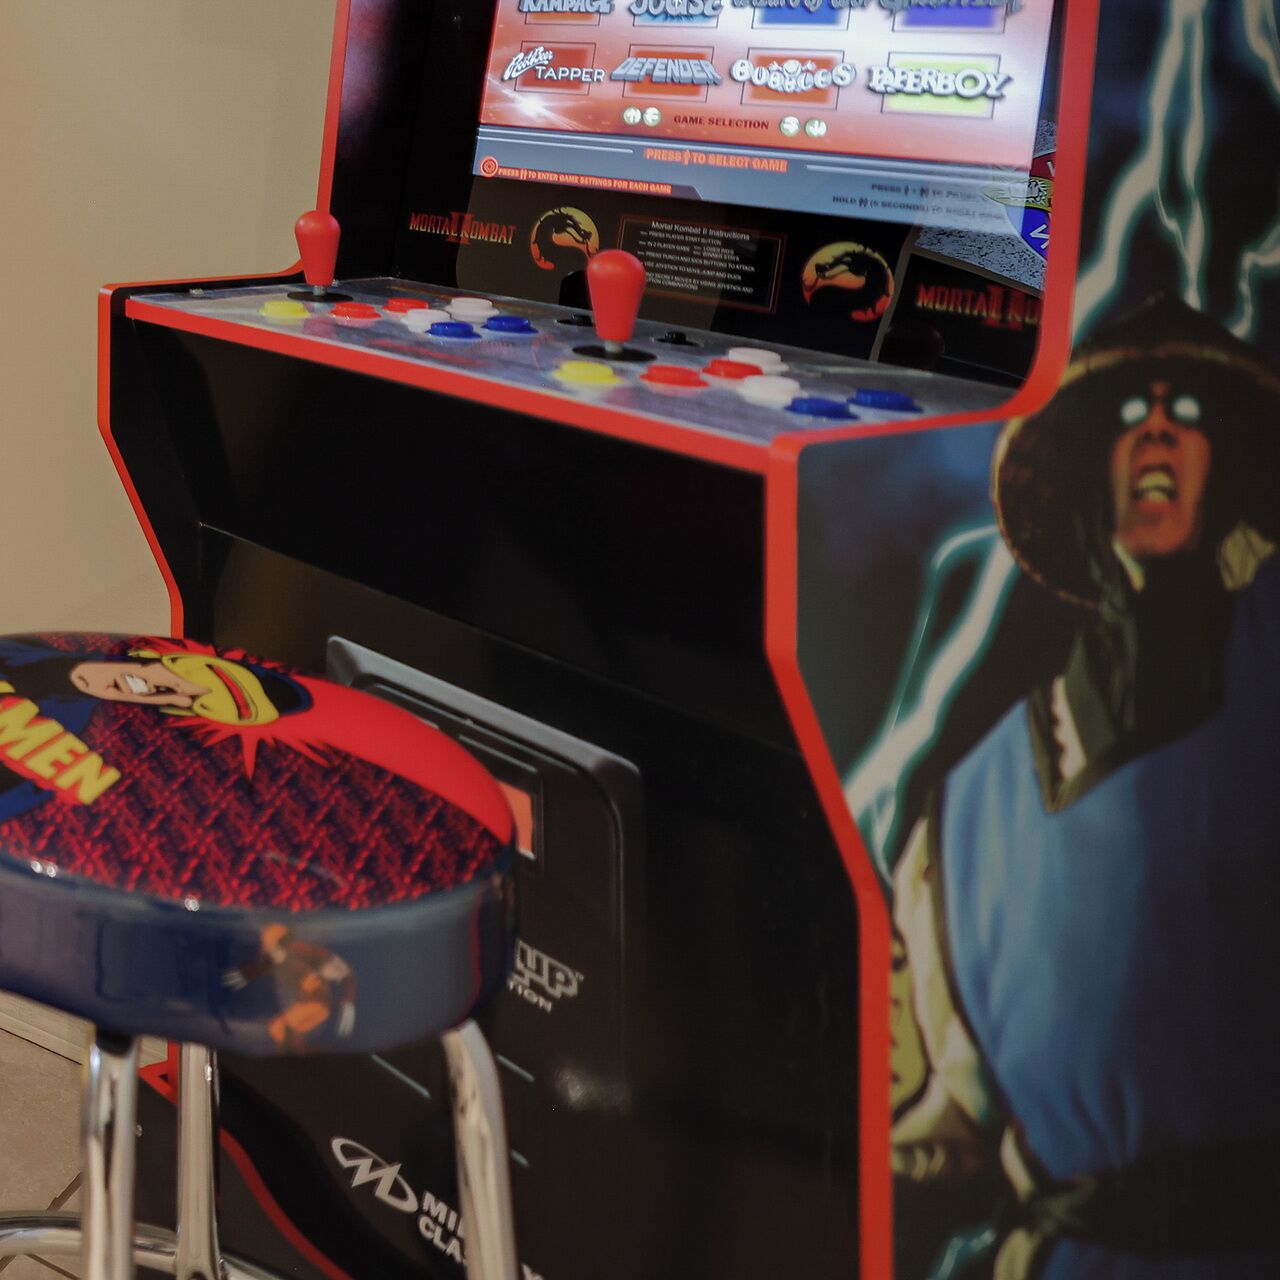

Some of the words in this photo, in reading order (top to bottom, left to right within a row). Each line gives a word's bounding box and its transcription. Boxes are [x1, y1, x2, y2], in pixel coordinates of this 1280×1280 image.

[535, 65, 606, 83] TAPPER
[611, 56, 722, 85] DEFENDER
[867, 66, 1013, 100] PAPERBOY
[673, 115, 708, 126] GAME
[710, 116, 770, 130] SELECTION
[644, 148, 681, 163] PRESS
[691, 152, 706, 164] TO
[708, 153, 750, 169] SELECT
[752, 158, 788, 172] GAME
[409, 212, 458, 237] MORTAL
[460, 219, 517, 245] KOMBAT
[651, 221, 673, 231] Mortal
[674, 223, 701, 235] Kombat
[709, 227, 750, 241] Instructions
